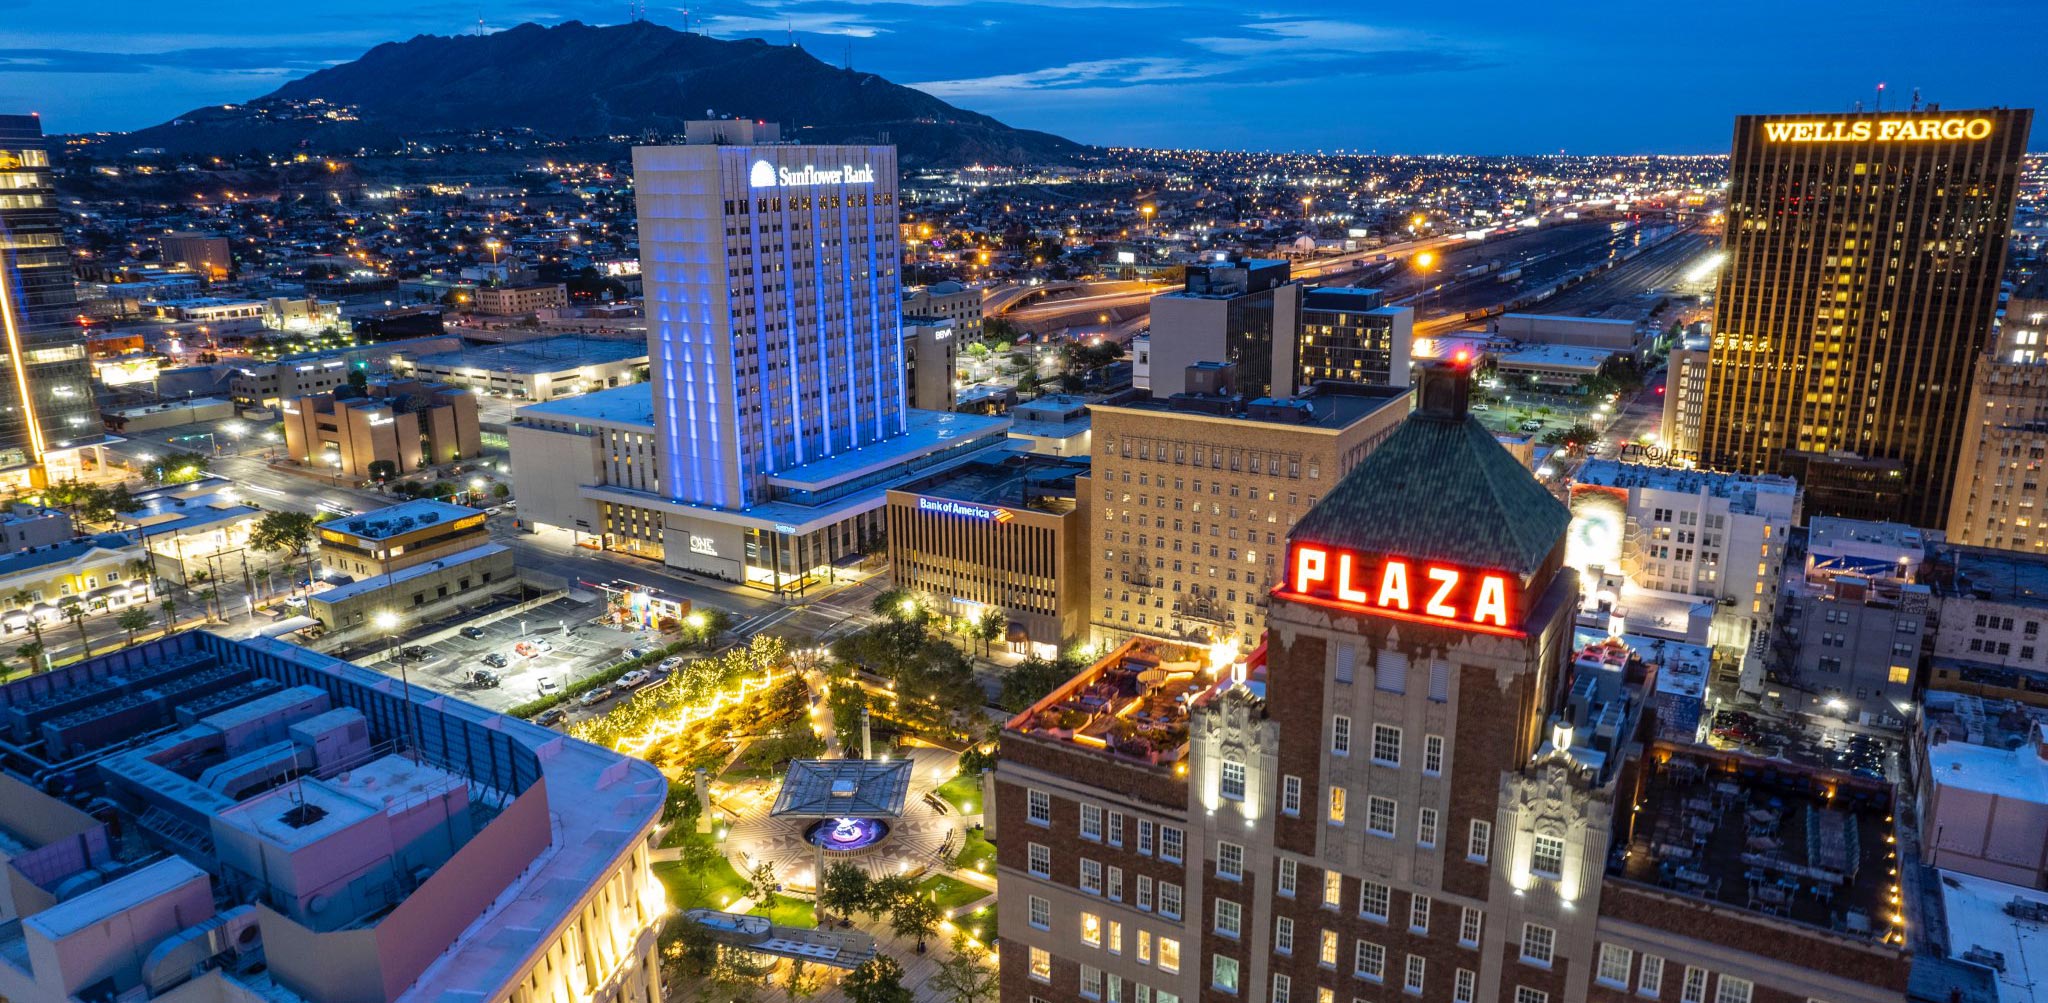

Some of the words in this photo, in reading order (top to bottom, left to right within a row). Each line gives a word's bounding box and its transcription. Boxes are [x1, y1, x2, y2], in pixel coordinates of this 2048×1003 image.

[1764, 121, 1871, 142] WELLS
[1876, 118, 1992, 140] FARGO
[779, 164, 842, 186] Sunflower
[843, 163, 874, 184] Bank
[935, 328, 952, 340] BBVA
[920, 498, 942, 511] Bank
[943, 502, 953, 512] of
[952, 503, 990, 519] America
[690, 536, 714, 552] ONE
[1297, 548, 1507, 626] PLAZA
